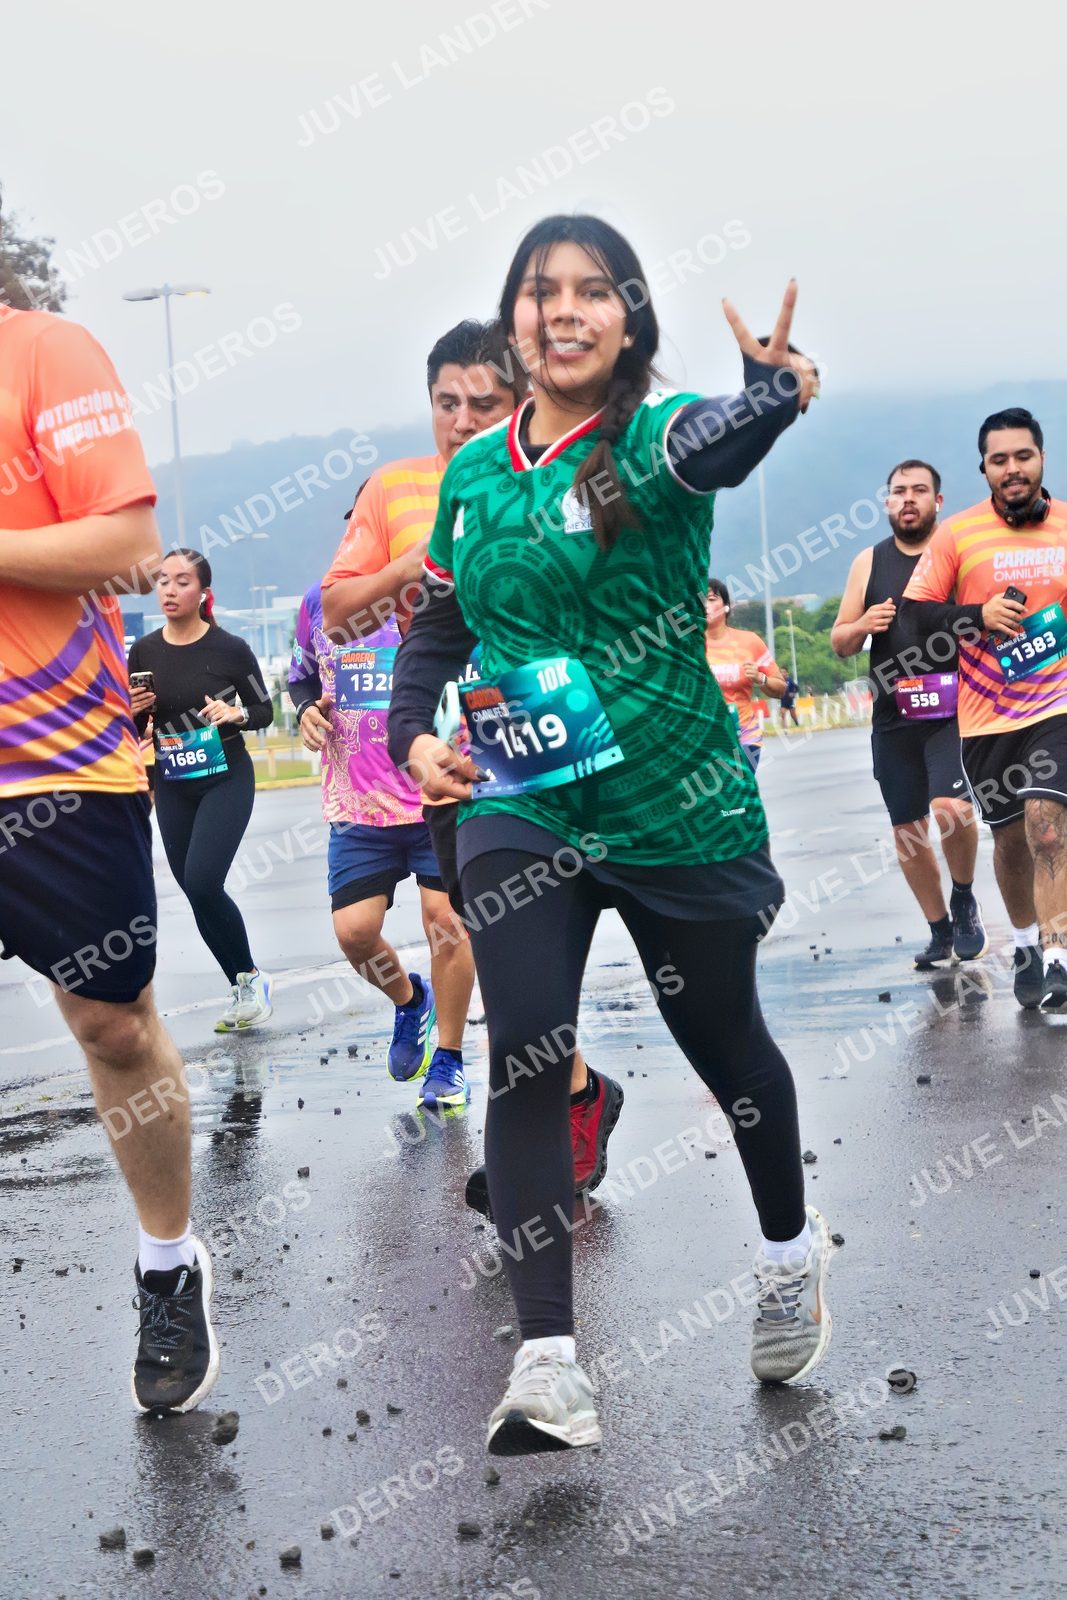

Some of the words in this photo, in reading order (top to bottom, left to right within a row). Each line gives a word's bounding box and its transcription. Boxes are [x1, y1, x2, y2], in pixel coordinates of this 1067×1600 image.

[566, 521, 592, 531] MEXI
[993, 546, 1065, 569] CARRERA
[993, 566, 1049, 582] OMNILIFE
[1042, 608, 1057, 624] 10K
[1011, 631, 1057, 662] 1383
[341, 652, 375, 663] CARRERA
[536, 661, 572, 694] 10K
[910, 692, 940, 708] 558
[200, 730, 213, 742] 10K
[495, 713, 568, 759] 1419
[168, 749, 207, 767] 1686
